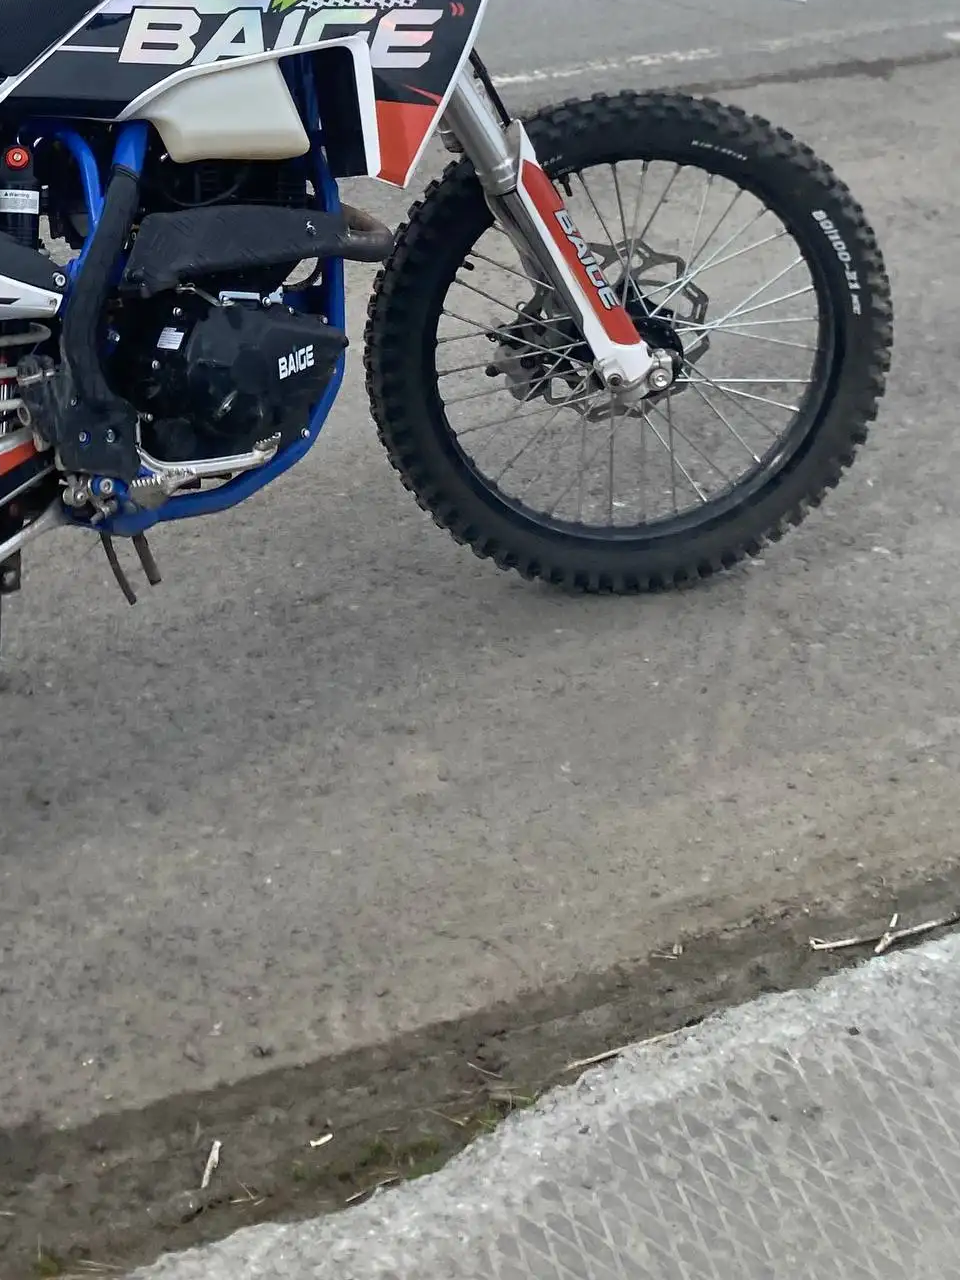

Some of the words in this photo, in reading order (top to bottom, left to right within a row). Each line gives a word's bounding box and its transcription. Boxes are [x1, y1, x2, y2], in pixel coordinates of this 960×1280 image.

[119, 6, 444, 69] BAIGE
[553, 207, 622, 311] BAIGE
[278, 344, 315, 380] BAIGE
